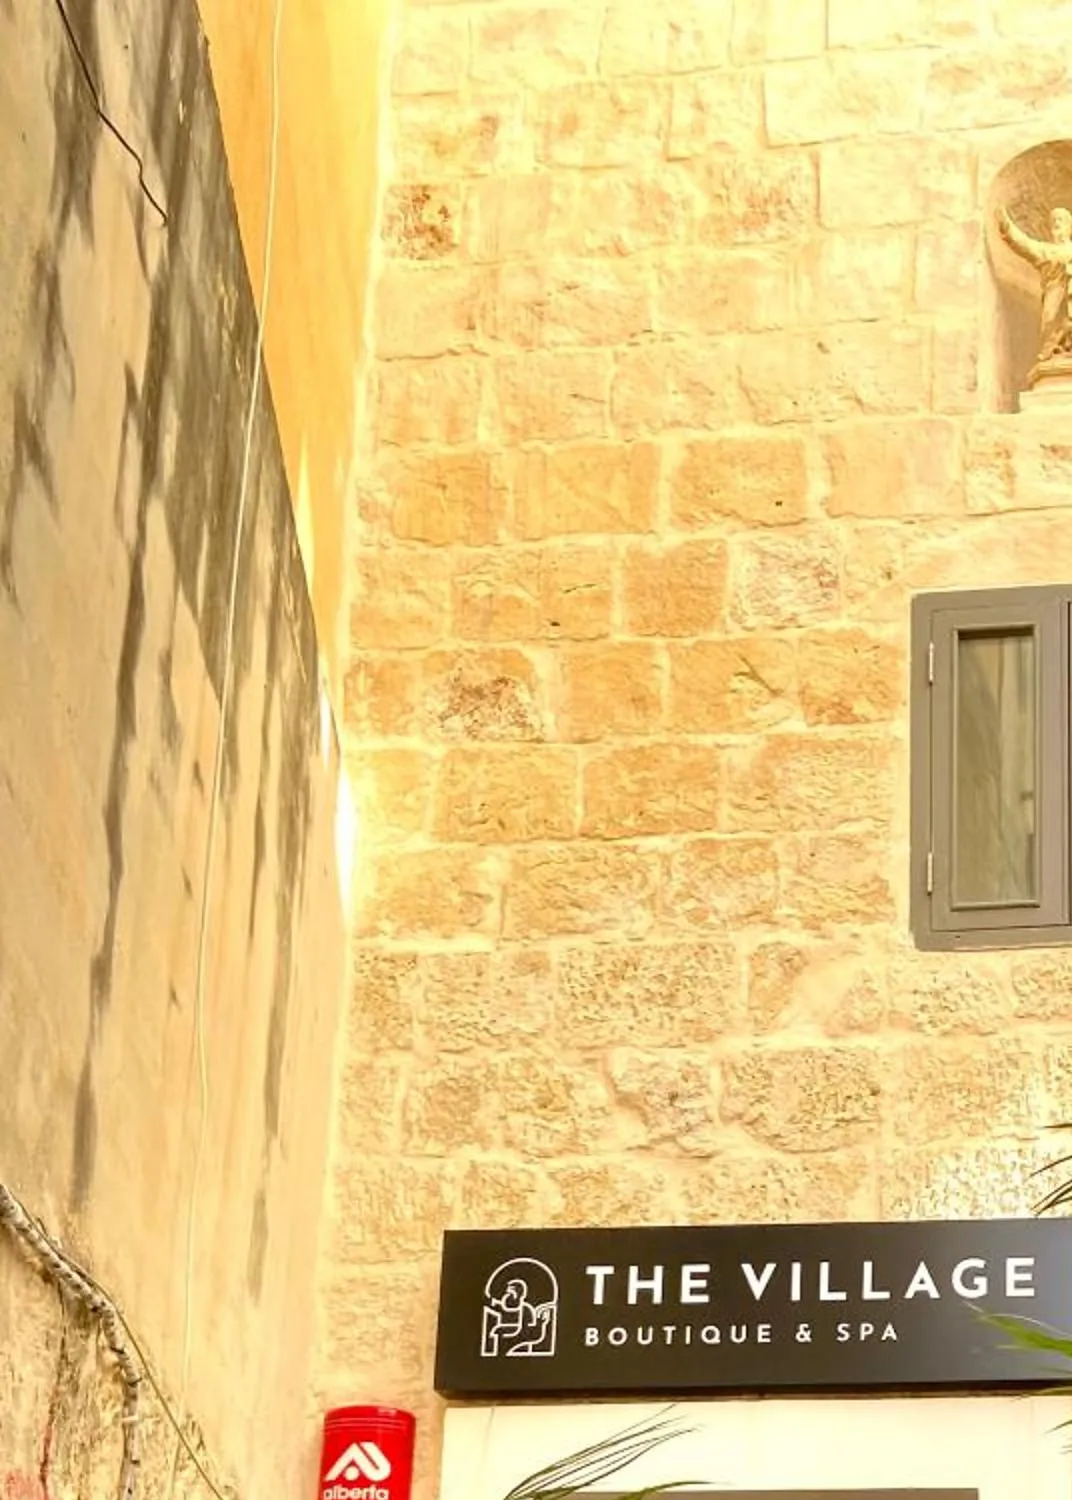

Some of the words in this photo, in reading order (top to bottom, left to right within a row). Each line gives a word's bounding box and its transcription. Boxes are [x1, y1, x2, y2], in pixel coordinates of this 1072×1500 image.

[585, 1263, 712, 1305] THE
[741, 1256, 1037, 1301] VILLAGE
[585, 1324, 772, 1346] BOUTIQUE
[795, 1323, 813, 1342] &
[836, 1322, 899, 1342] SPA
[323, 1484, 390, 1500] alberta
